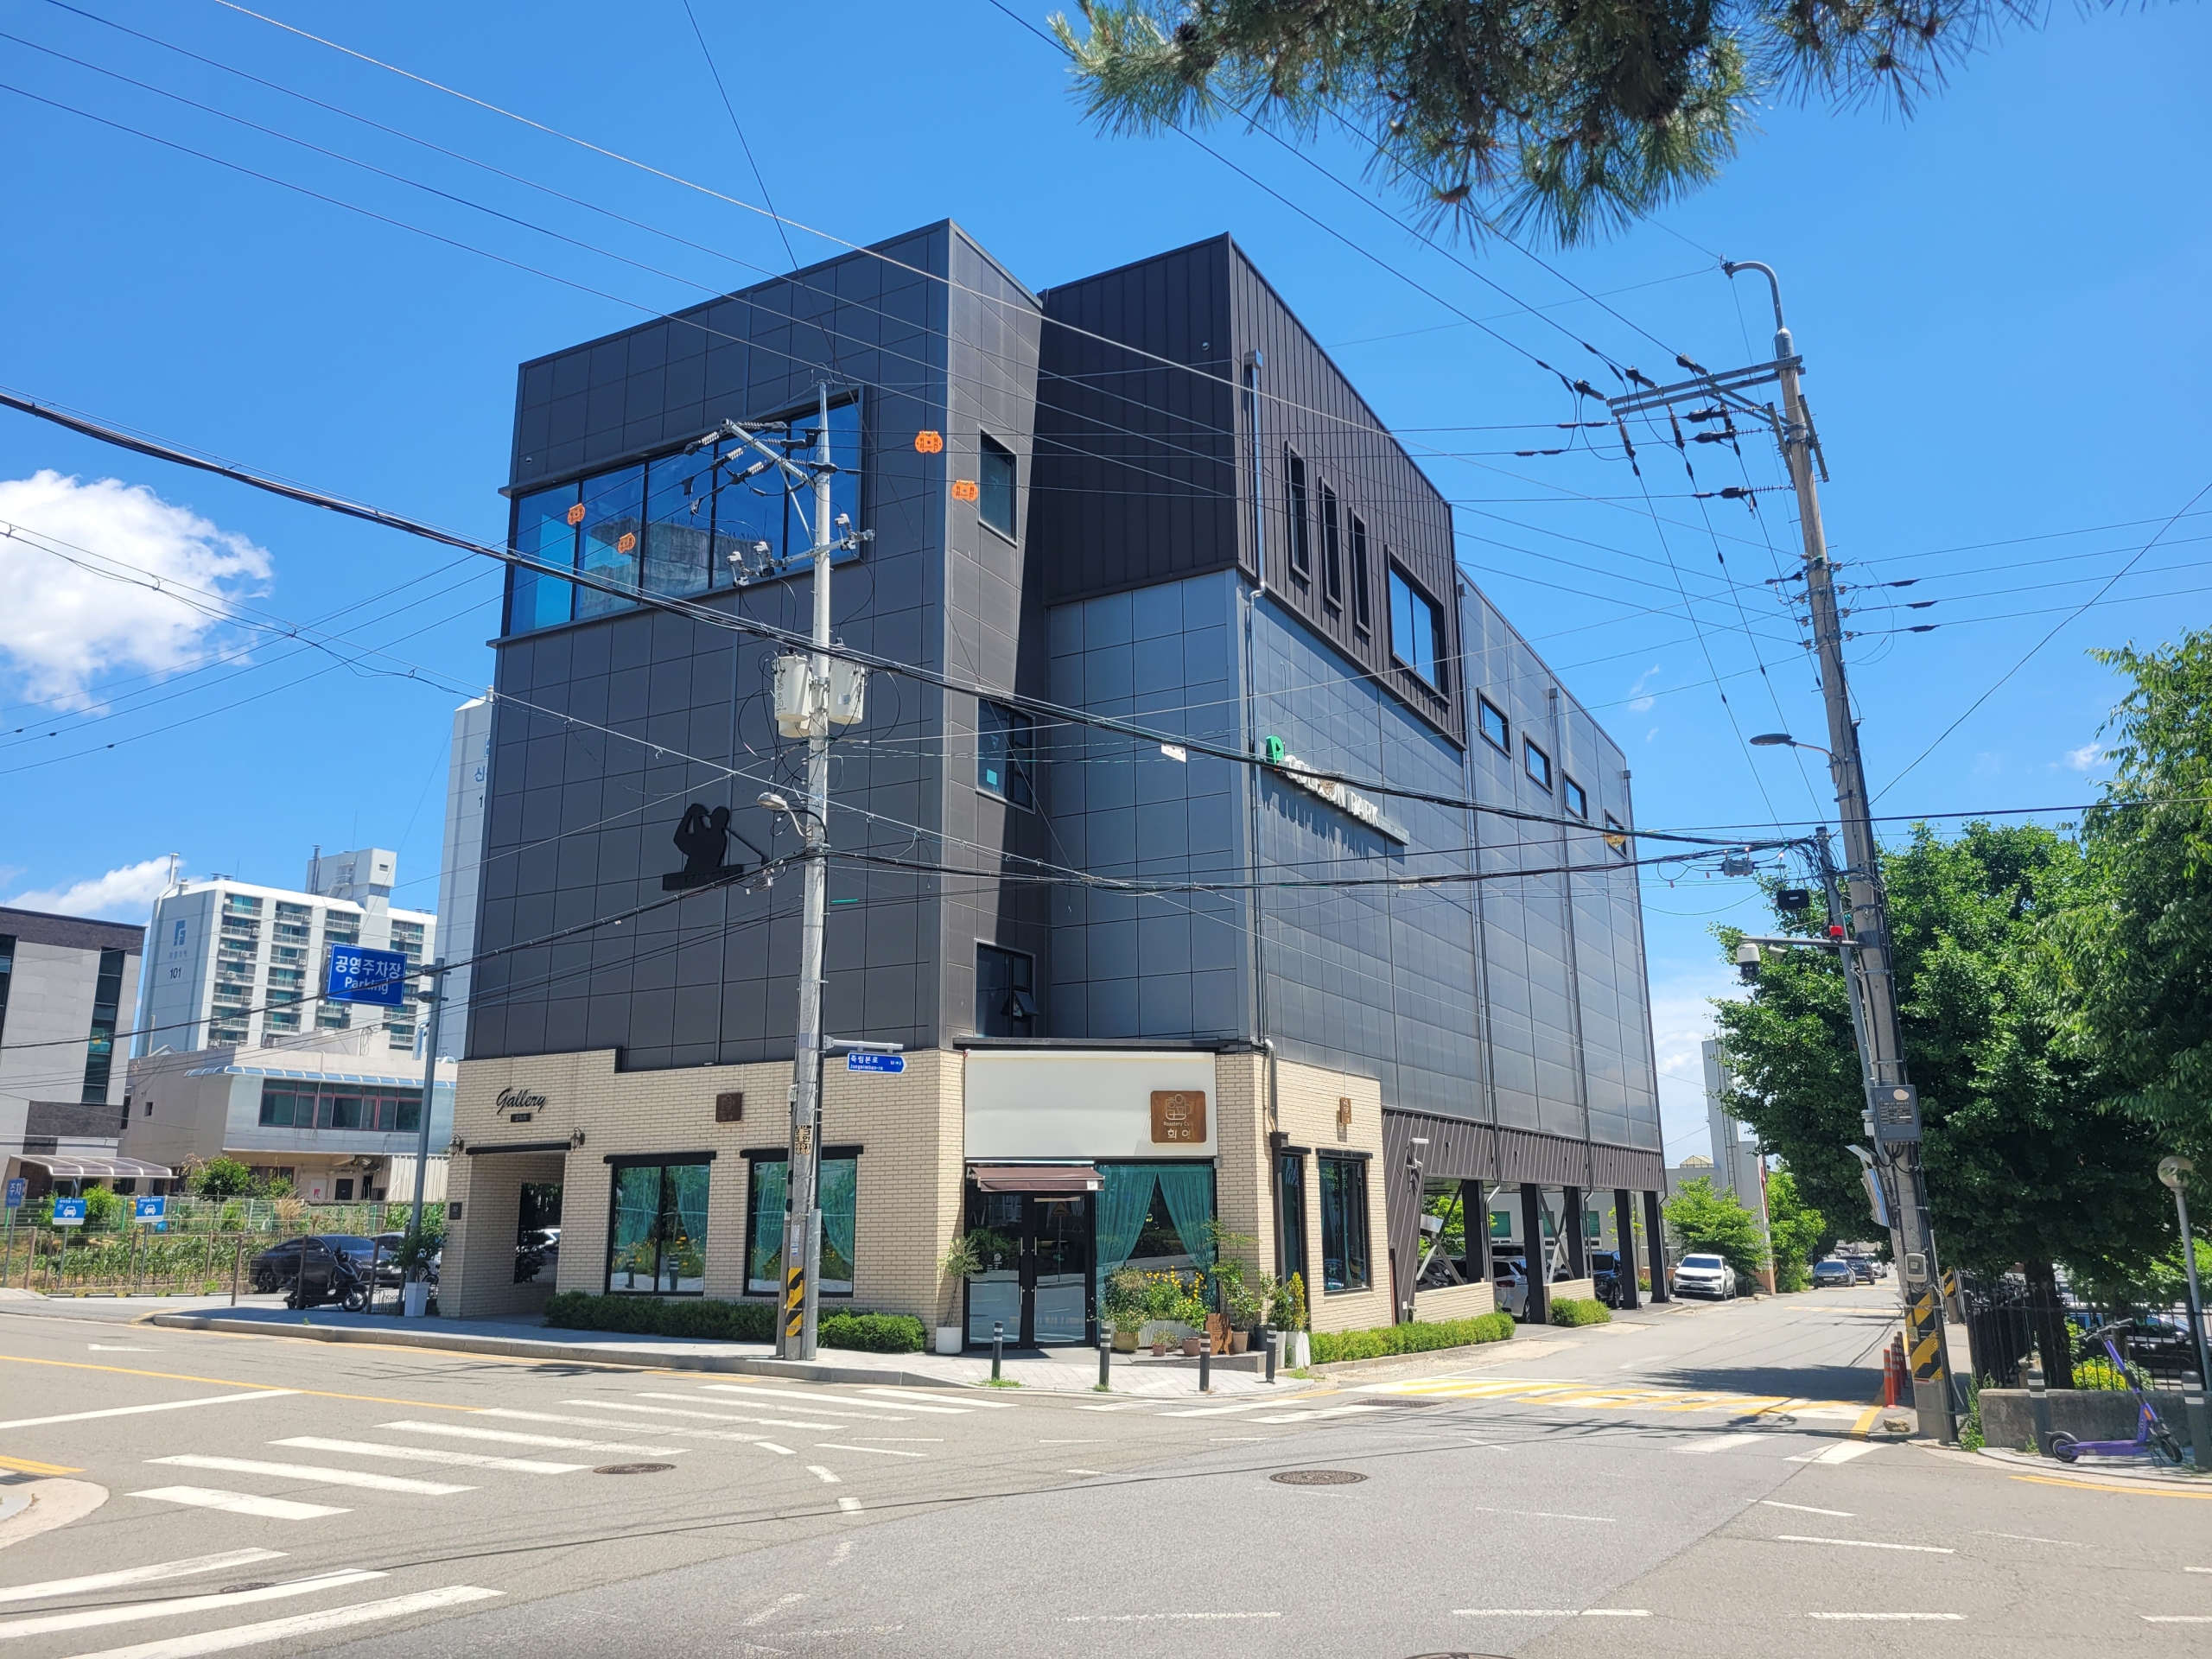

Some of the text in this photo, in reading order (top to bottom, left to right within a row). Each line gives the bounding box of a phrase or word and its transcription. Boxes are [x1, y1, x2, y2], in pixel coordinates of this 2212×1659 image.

[474, 766, 488, 782] 신
[1346, 791, 1379, 827] PARK
[169, 967, 182, 979] 101
[335, 955, 402, 979] 공영주차장
[345, 976, 389, 995] Parking
[496, 1088, 547, 1116] Gallery
